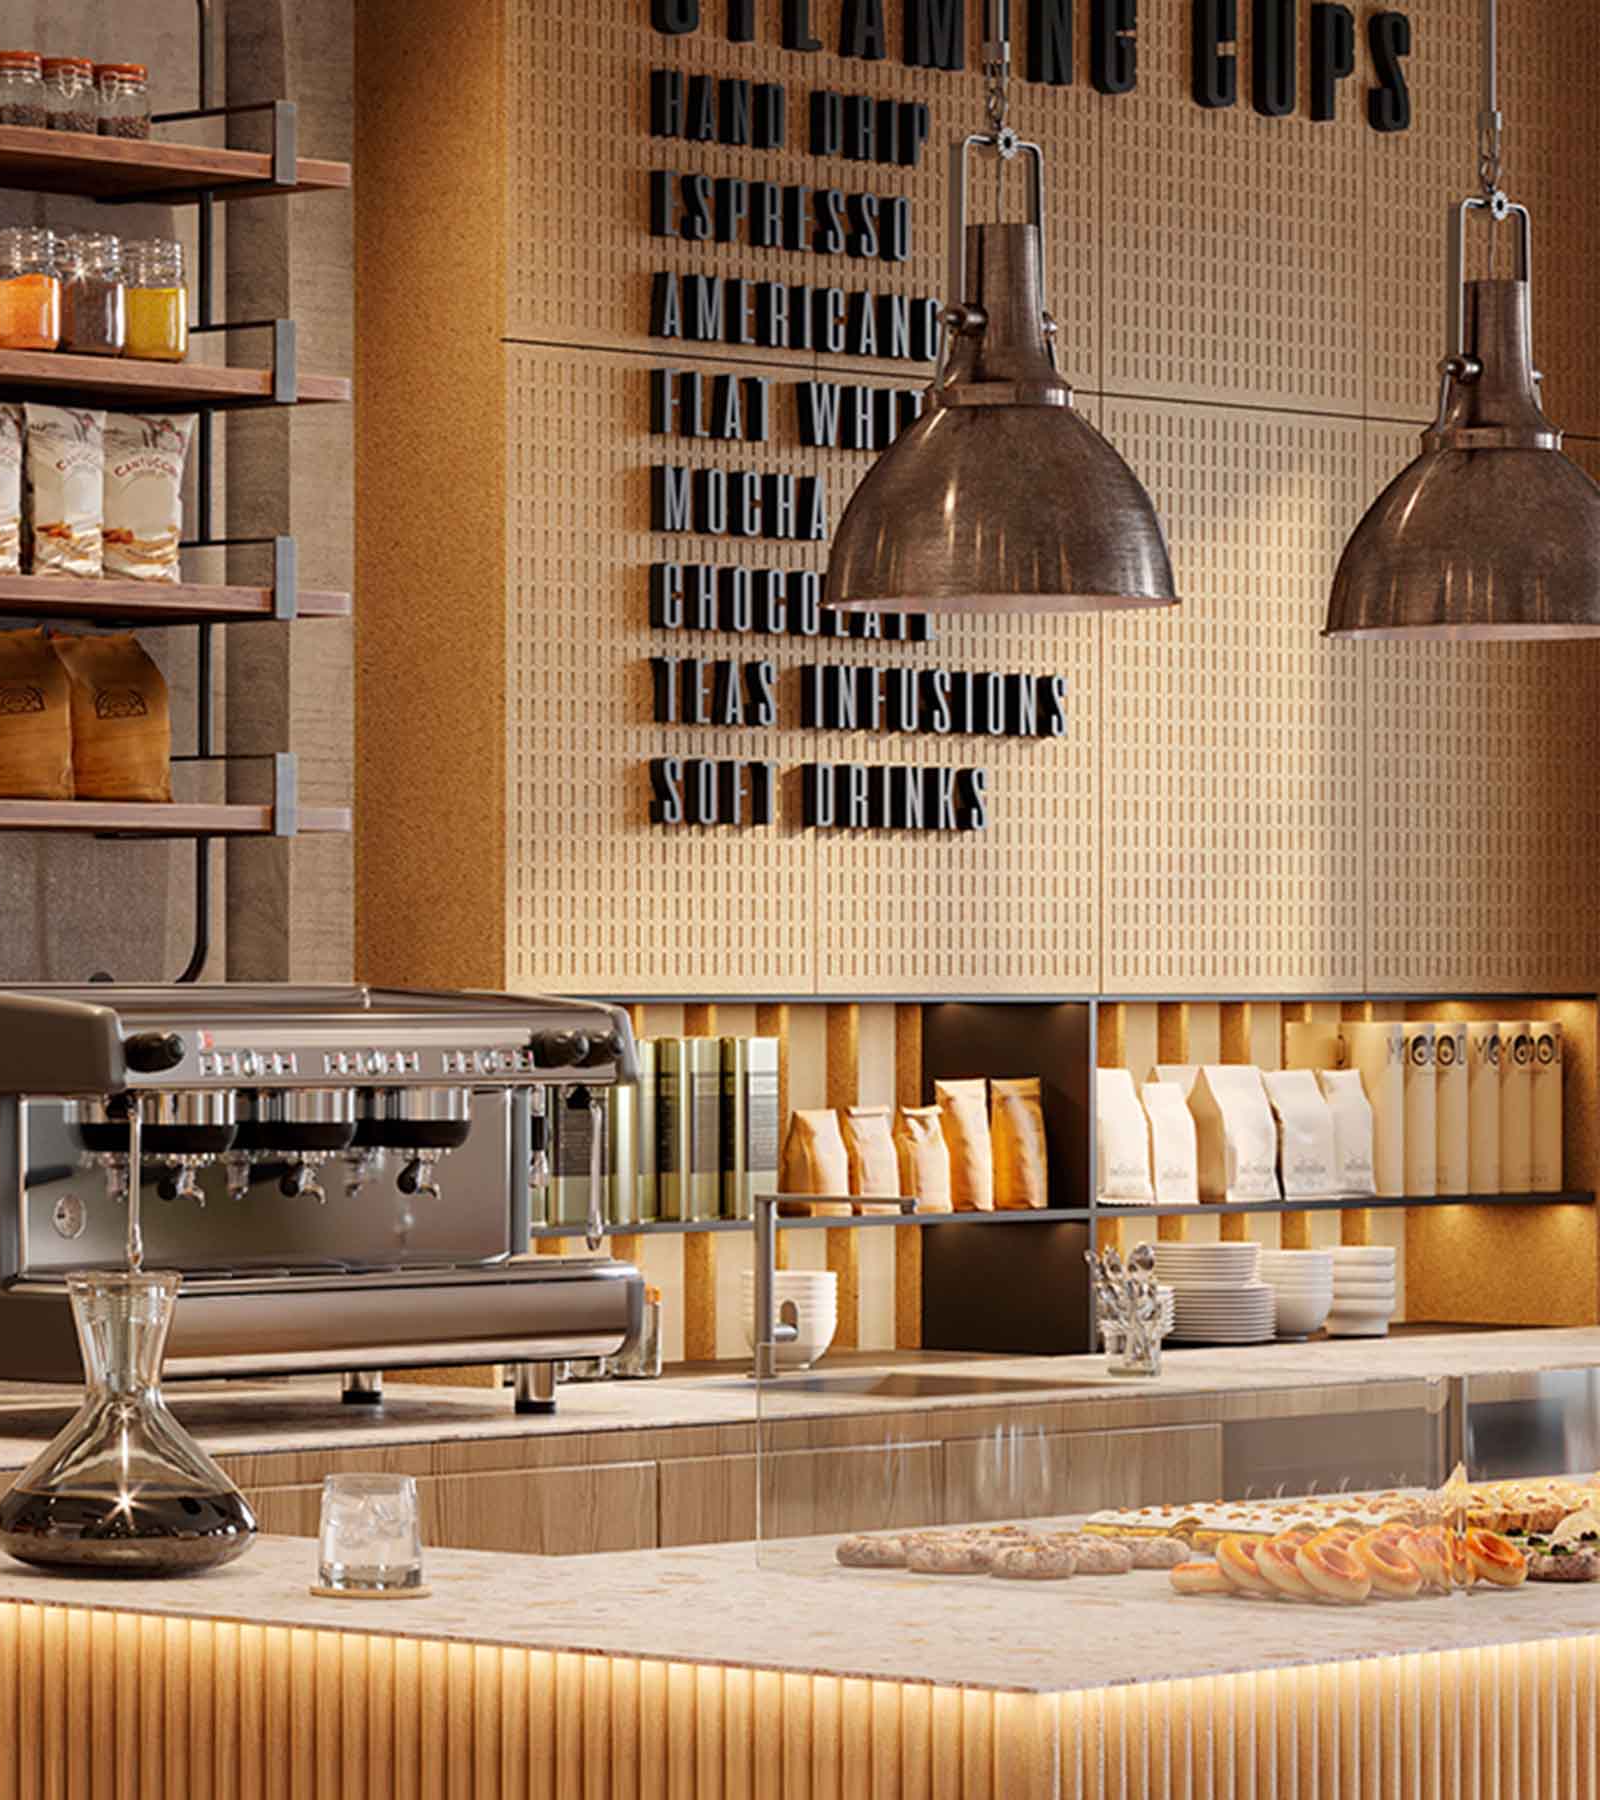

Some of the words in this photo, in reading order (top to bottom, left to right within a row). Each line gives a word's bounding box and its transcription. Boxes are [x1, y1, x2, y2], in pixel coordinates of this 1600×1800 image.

[1191, 0, 1411, 132] CUPS
[650, 70, 785, 149] HAND
[810, 90, 930, 166] DRIP
[650, 170, 913, 263] ESPRESSO
[649, 272, 946, 361] AMERICANO
[651, 369, 772, 441] FLAT
[796, 381, 926, 450] WHIT
[650, 466, 829, 540] MOCHA
[650, 656, 779, 727] TEAS
[800, 664, 1069, 738] INFUSIONS
[650, 757, 778, 826] SOFT
[802, 763, 988, 833] DRINKS
